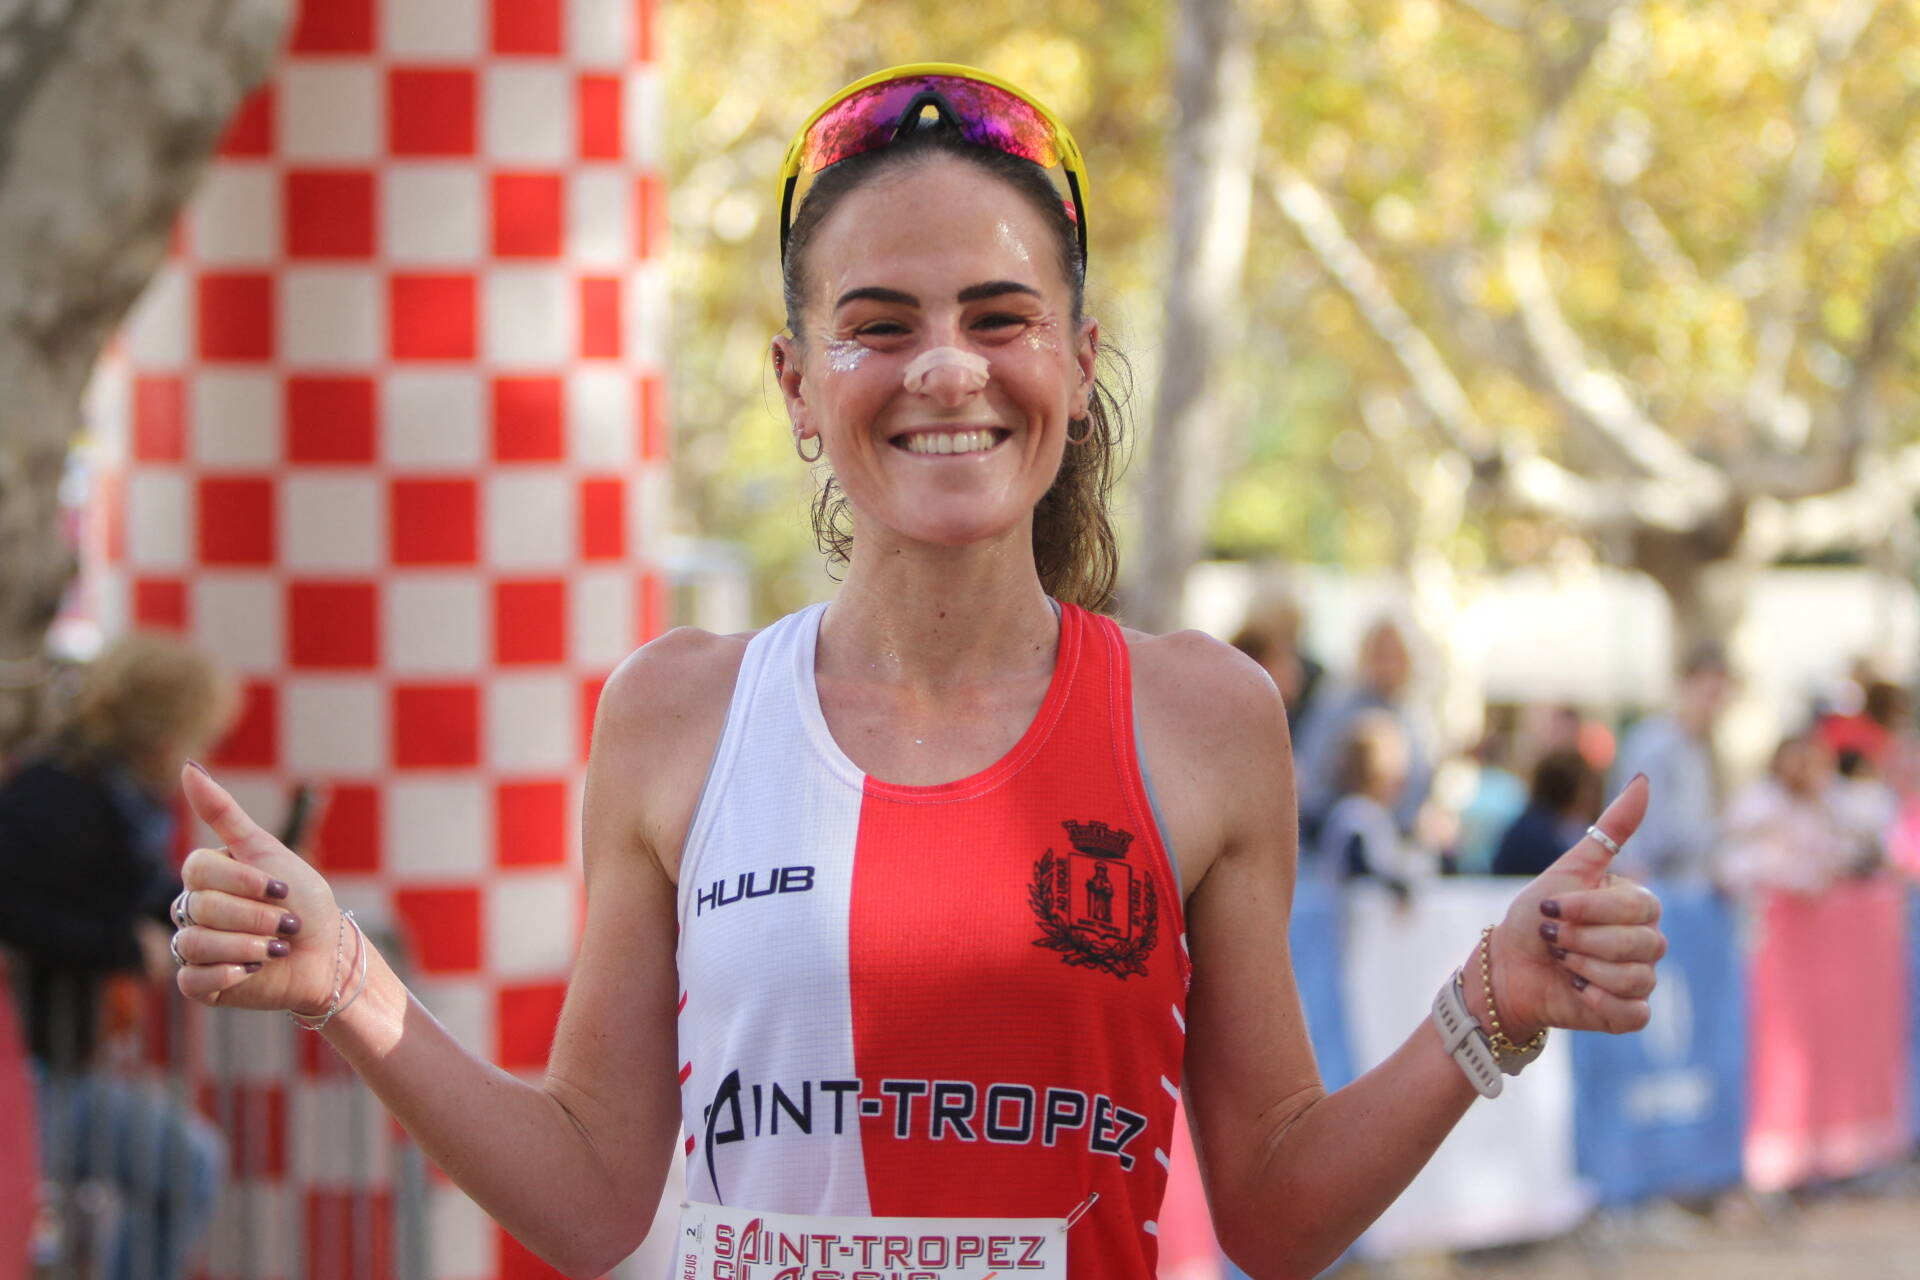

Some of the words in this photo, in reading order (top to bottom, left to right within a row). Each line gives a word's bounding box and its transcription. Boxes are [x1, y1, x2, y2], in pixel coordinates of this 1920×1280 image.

[697, 865, 816, 917] HUUB
[703, 1068, 1148, 1206] AINT-TROPEZ
[714, 1217, 1046, 1277] SAINT-TROPEZ
